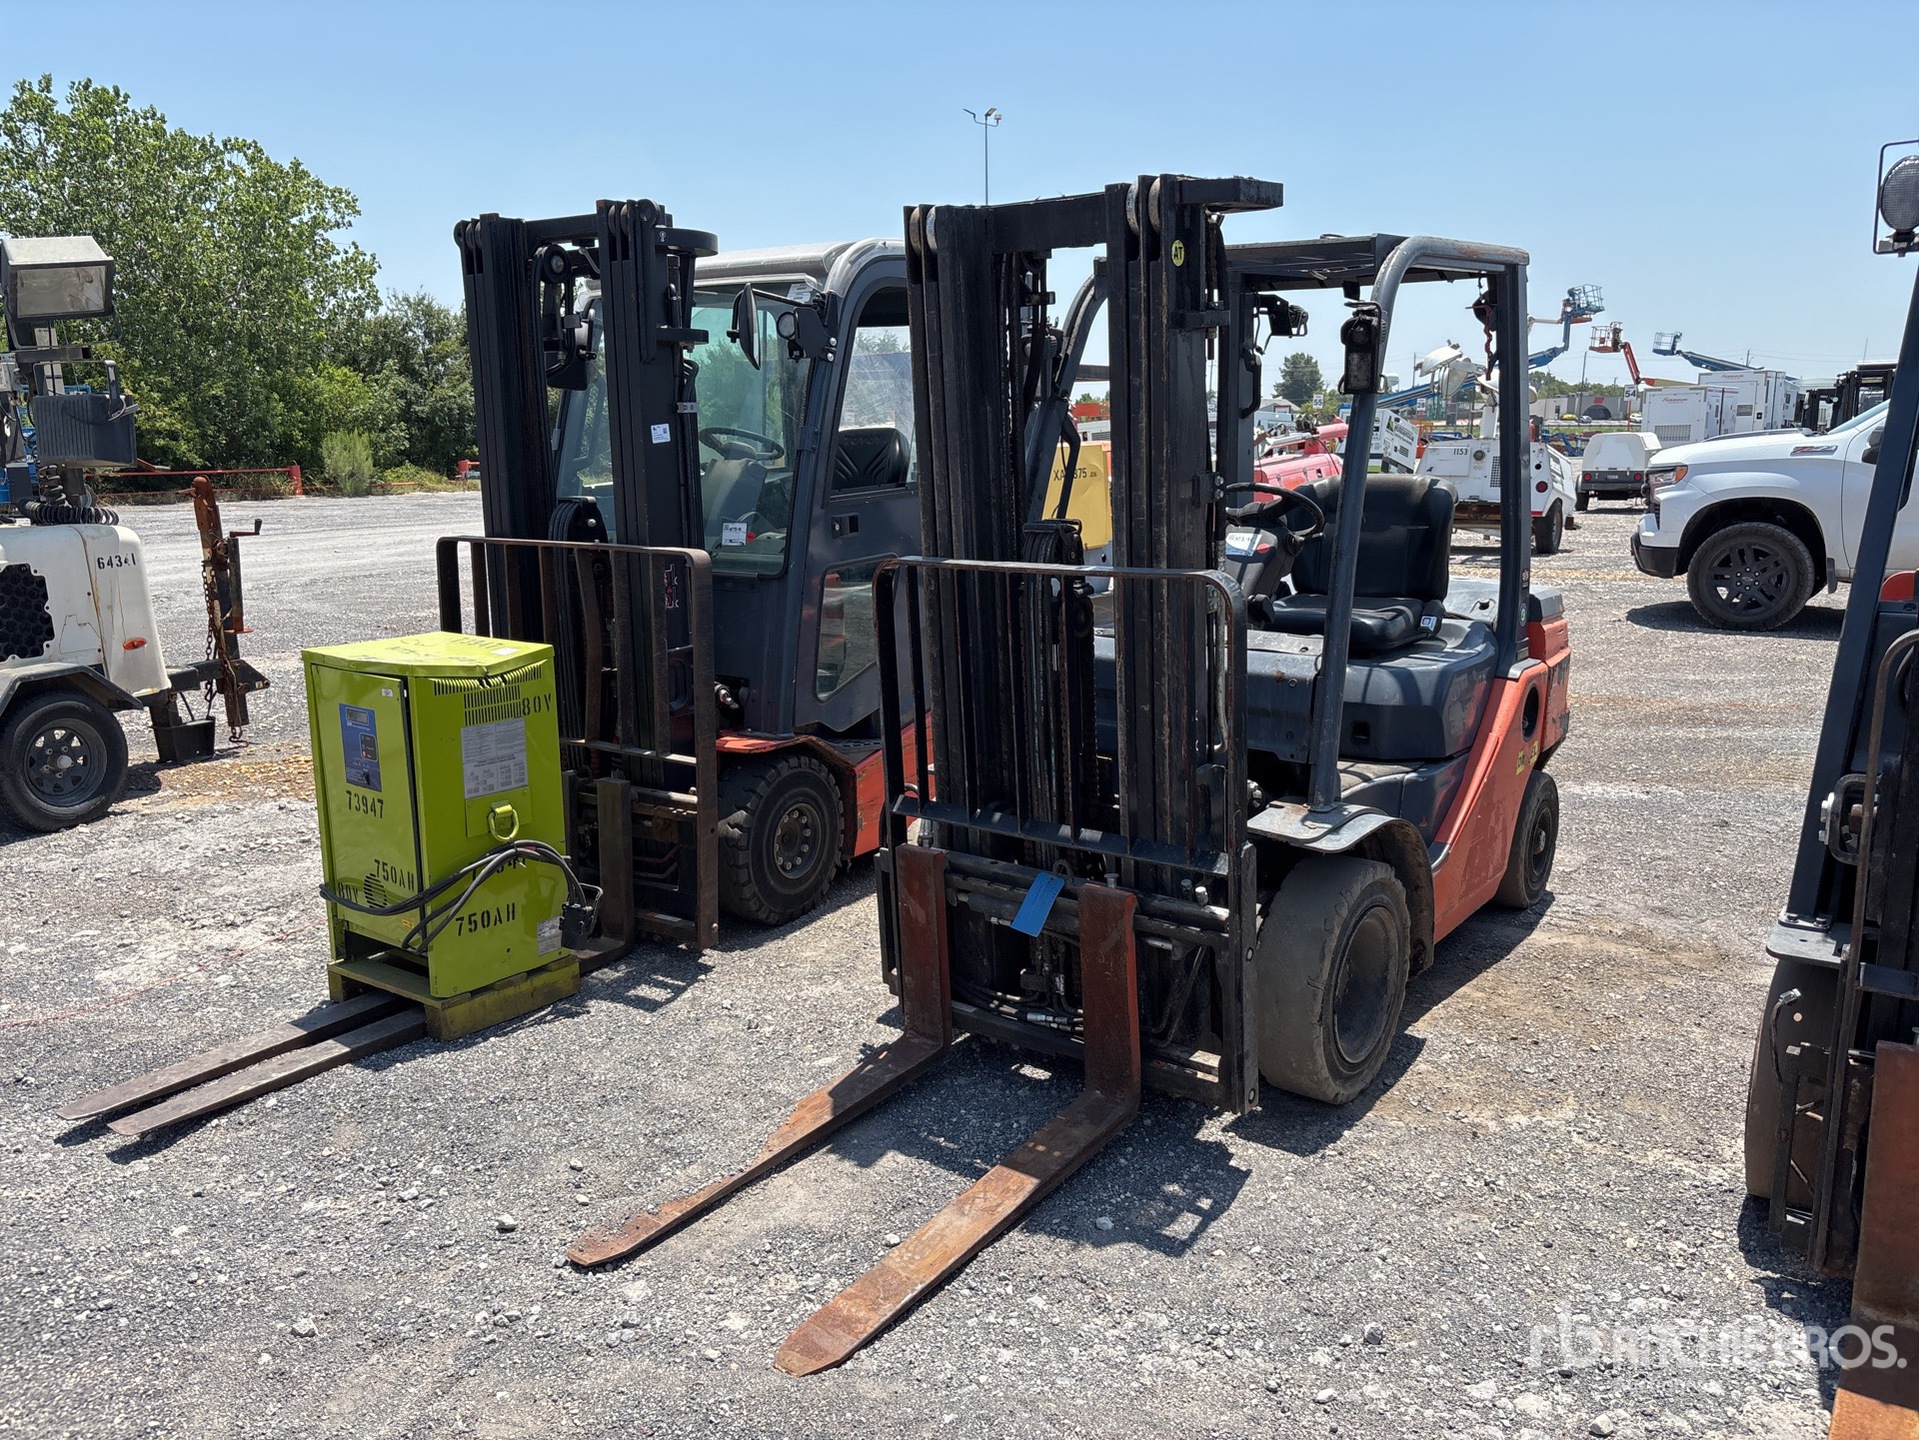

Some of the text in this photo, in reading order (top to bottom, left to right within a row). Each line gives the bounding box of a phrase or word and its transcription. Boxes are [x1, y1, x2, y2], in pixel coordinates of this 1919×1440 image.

[1174, 246, 1183, 260] AT
[1314, 398, 1323, 406] 55
[1625, 390, 1636, 398] 54
[1453, 448, 1468, 456] 1153
[522, 692, 552, 716] 80V
[346, 790, 384, 819] 73947
[374, 858, 415, 892] 750AH
[338, 881, 359, 904] 80V
[455, 902, 516, 937] 750AH
